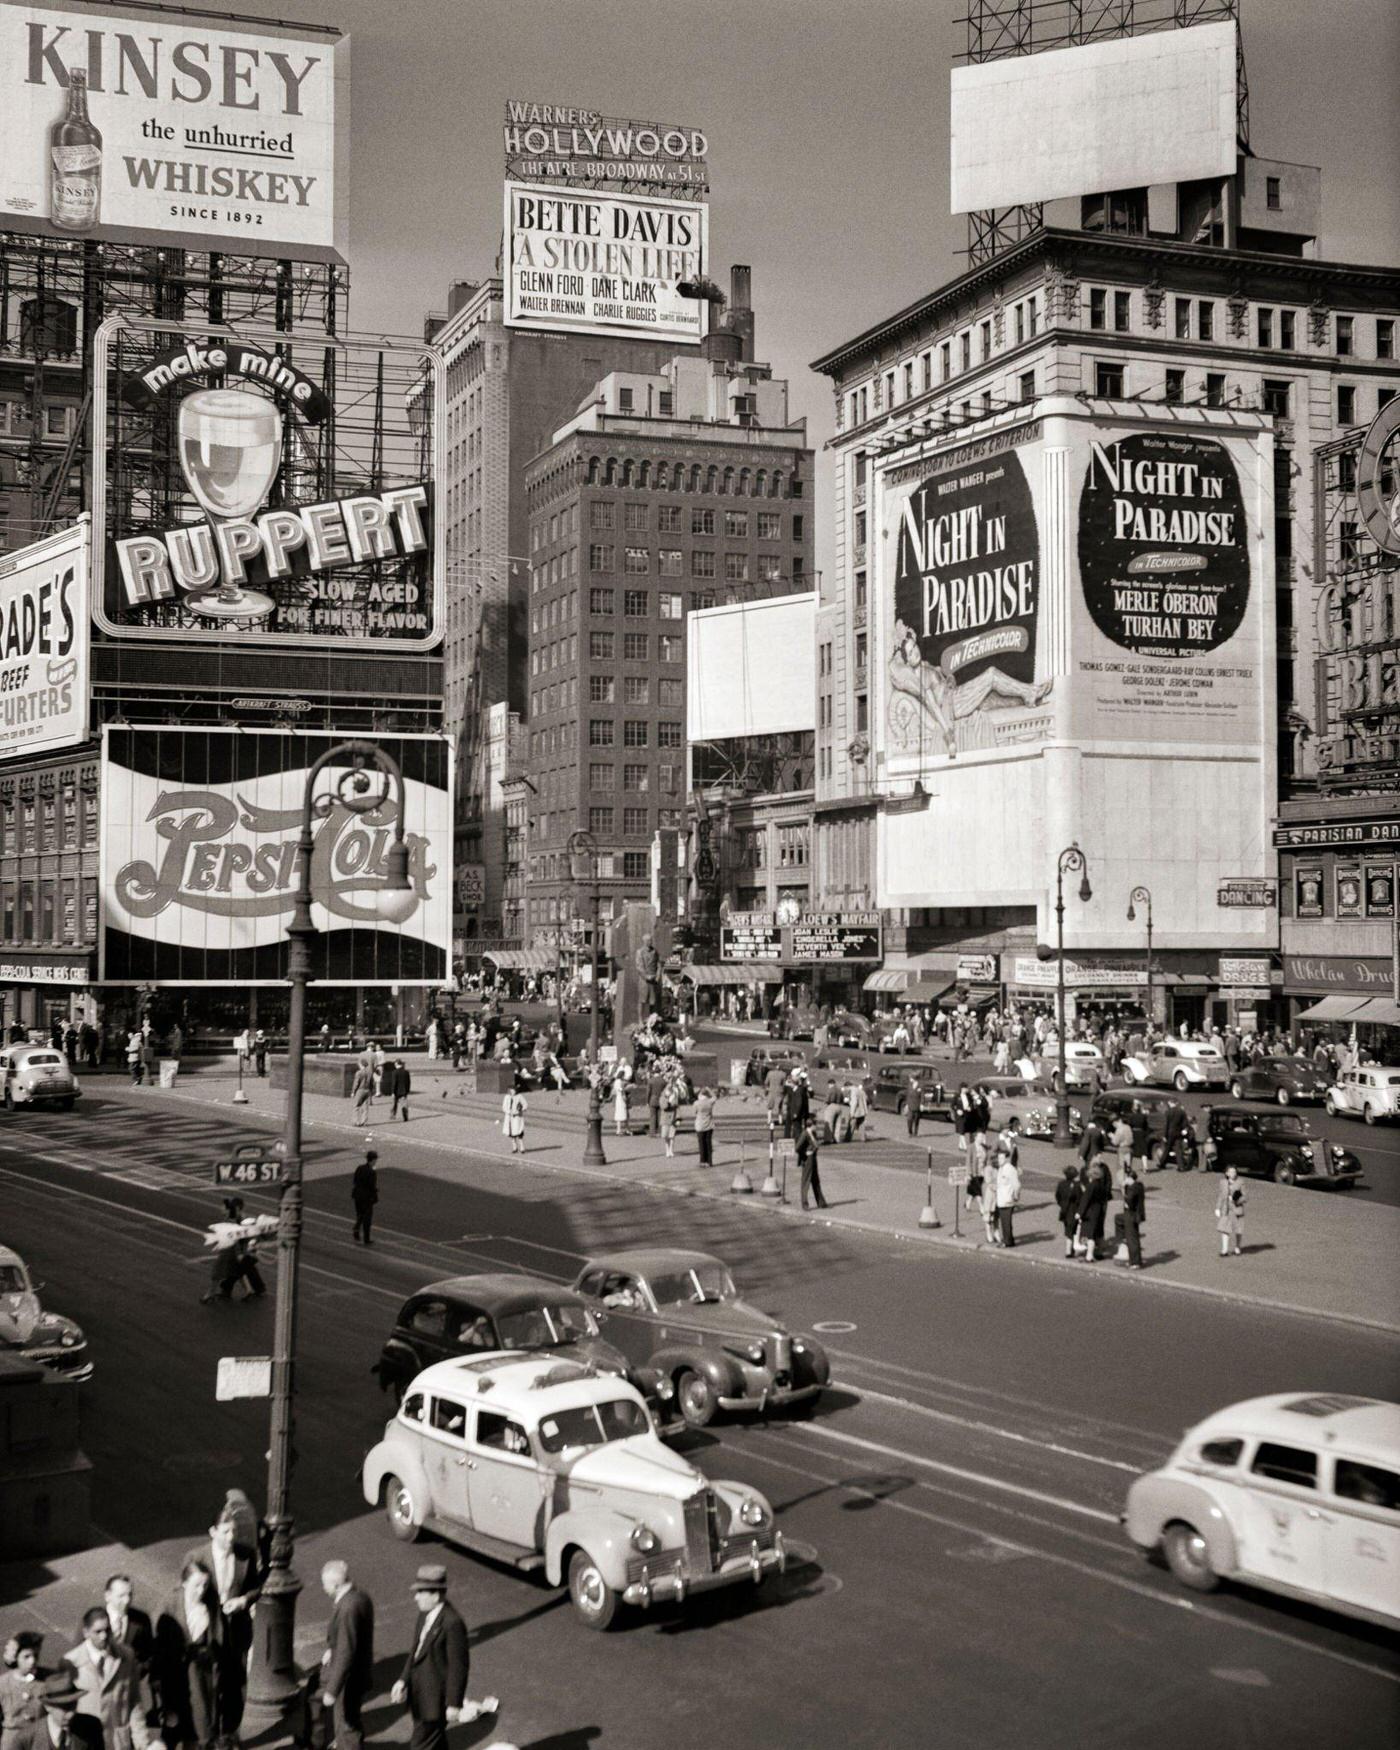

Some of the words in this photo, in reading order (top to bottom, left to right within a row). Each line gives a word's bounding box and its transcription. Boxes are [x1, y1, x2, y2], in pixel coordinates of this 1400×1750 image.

[24, 22, 321, 116] KINSEY
[142, 119, 175, 140] the
[185, 124, 294, 153] unhurried
[503, 126, 709, 157] HOLLYWOOD
[122, 155, 318, 207] WHISKEY
[522, 161, 578, 177] THEATRE
[587, 162, 666, 181] BROADWAY
[170, 206, 219, 220] SINCE
[227, 211, 264, 225] 1892
[517, 197, 601, 237] BETTE
[613, 206, 692, 247] DAVIS
[543, 236, 634, 278] STOLEN
[519, 270, 554, 294] GLENN
[557, 273, 584, 297] FORD
[592, 277, 618, 300] DANE
[622, 281, 657, 304] CLARK
[551, 298, 586, 315] BRENNAN
[593, 303, 623, 320] CHARLIE
[142, 344, 229, 394] make
[239, 351, 313, 401] mine
[989, 423, 1040, 453] CRITERION
[1087, 439, 1199, 497] NIGHT
[1200, 476, 1223, 499] IN
[901, 489, 983, 578] NIGHT
[986, 515, 1007, 555] IN
[1113, 498, 1236, 547] PARADISE
[115, 486, 428, 606] RUPPERT
[1145, 554, 1201, 569] TECHNICOLOR
[0, 566, 74, 661] ADE'S
[922, 560, 1034, 639] PARADISE
[1114, 589, 1159, 612] MERLE
[1163, 592, 1218, 616] OBERON
[277, 606, 311, 624] FOR
[368, 610, 427, 630] FLAVOR
[1122, 615, 1181, 639] TURHAN
[1187, 618, 1216, 640] BEY
[950, 651, 961, 670] IN
[962, 631, 1022, 662] TECHNICOLOR
[1304, 827, 1363, 842] PARISIAN
[461, 881, 481, 892] BECK
[1220, 891, 1273, 904] DANCING
[841, 913, 879, 925] MAYFAIR
[1223, 972, 1267, 983] DRUGS
[1291, 960, 1345, 982] Whelan
[235, 1163, 257, 1181] 46
[261, 1163, 280, 1180] ST
